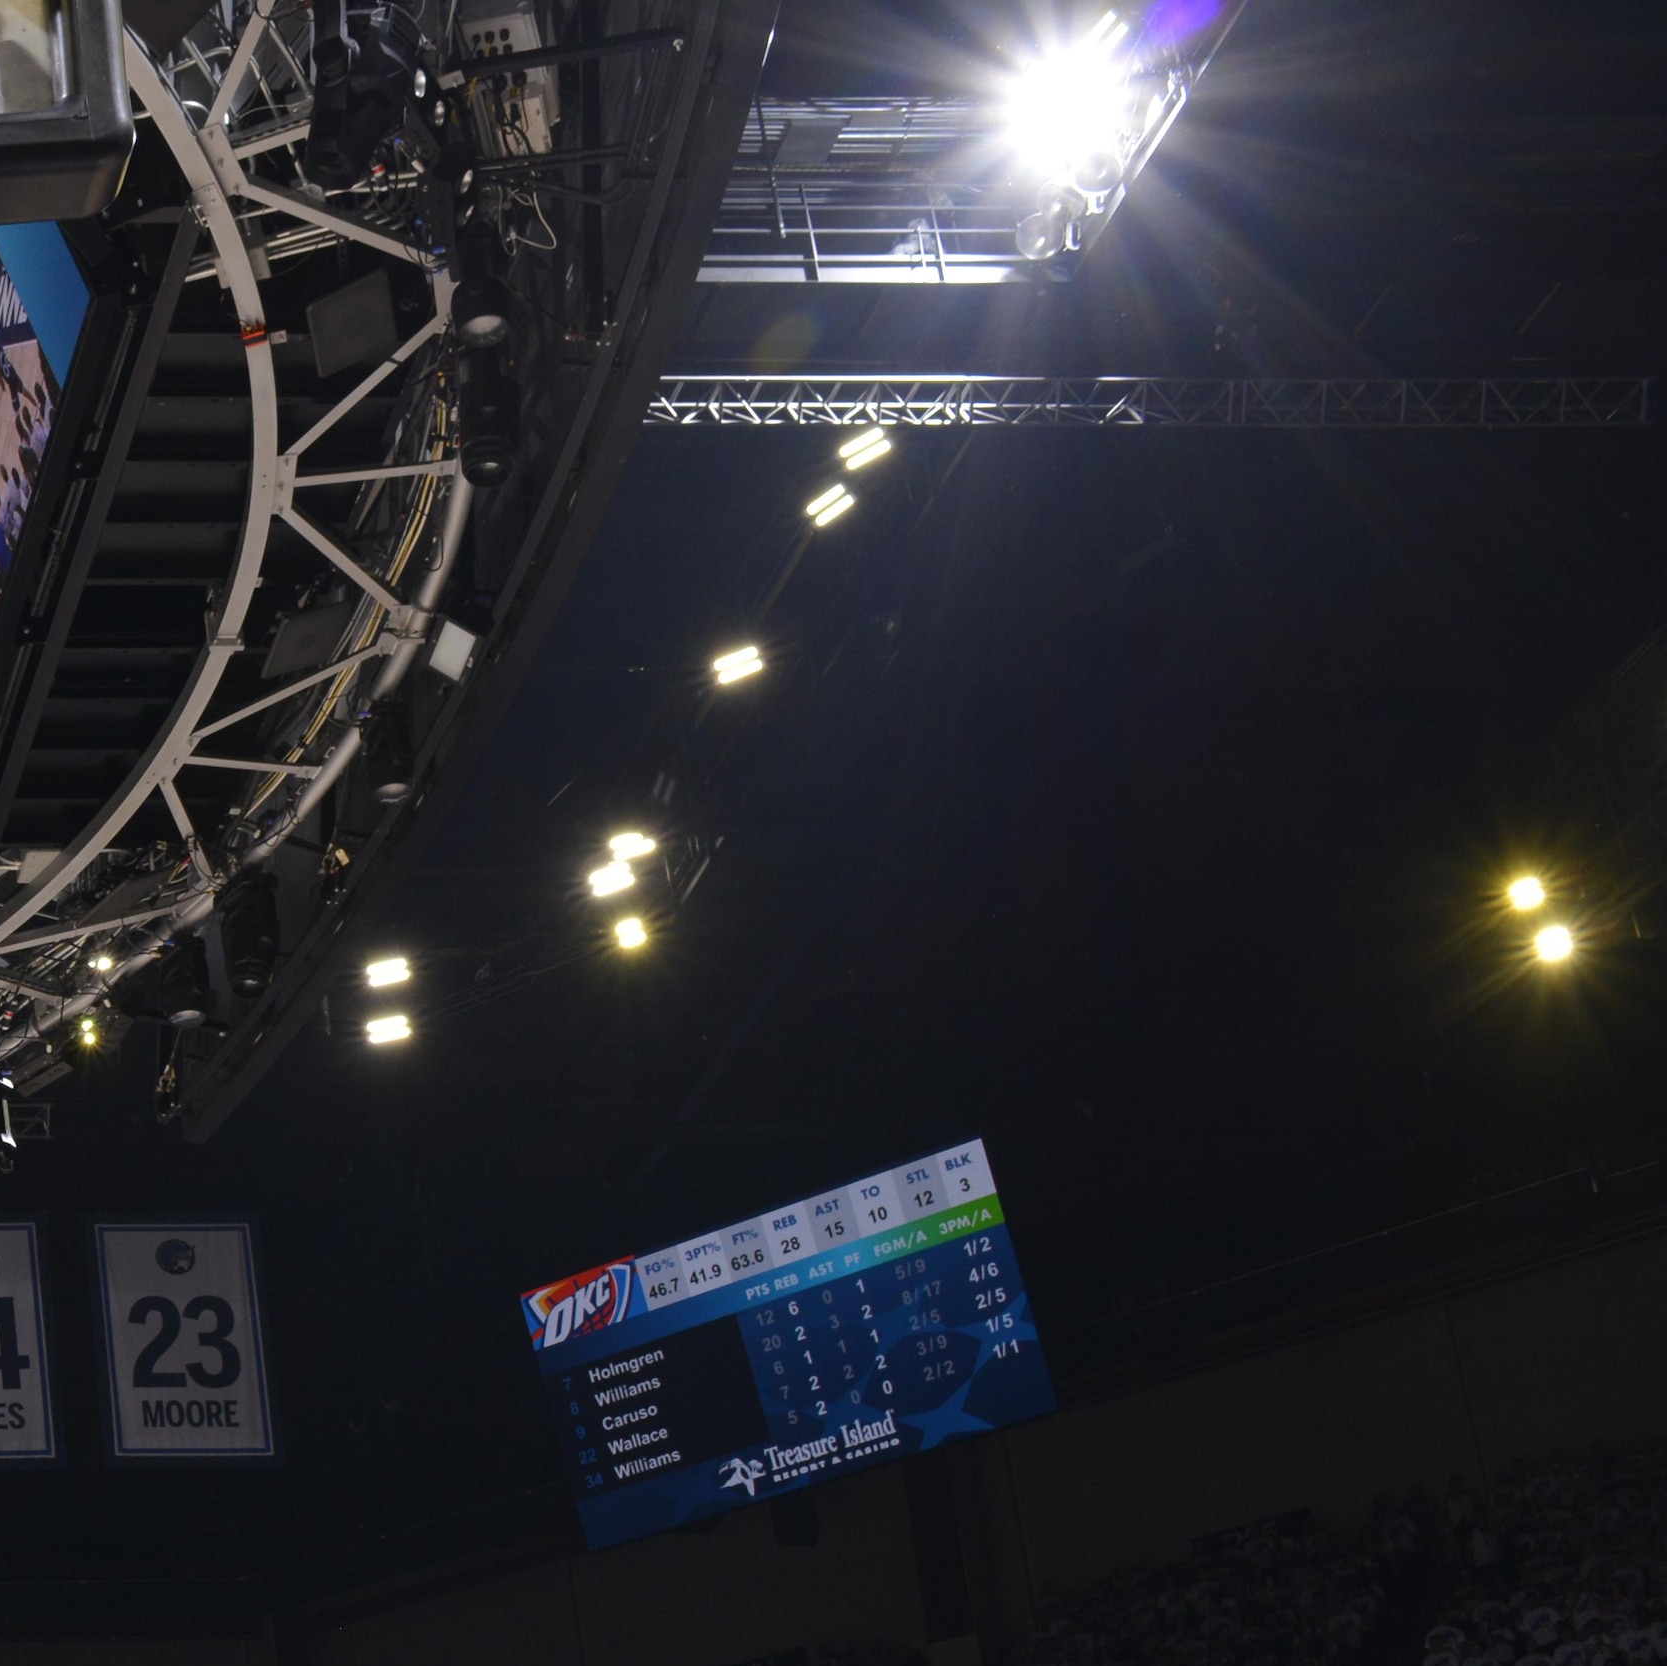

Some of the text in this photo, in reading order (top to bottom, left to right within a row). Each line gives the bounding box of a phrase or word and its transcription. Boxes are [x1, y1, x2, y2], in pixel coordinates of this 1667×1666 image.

[543, 1272, 611, 1348] OKC
[128, 1295, 241, 1388] 23
[588, 1350, 664, 1383] Holmgren
[595, 1376, 661, 1407] Williams
[143, 1400, 240, 1428] MOORE
[602, 1404, 658, 1430] Caruso
[608, 1427, 668, 1455] Wallace
[764, 1409, 896, 1470] Treasure Island
[614, 1450, 681, 1480] Williams
[773, 1438, 900, 1482] RESORT CASINO
